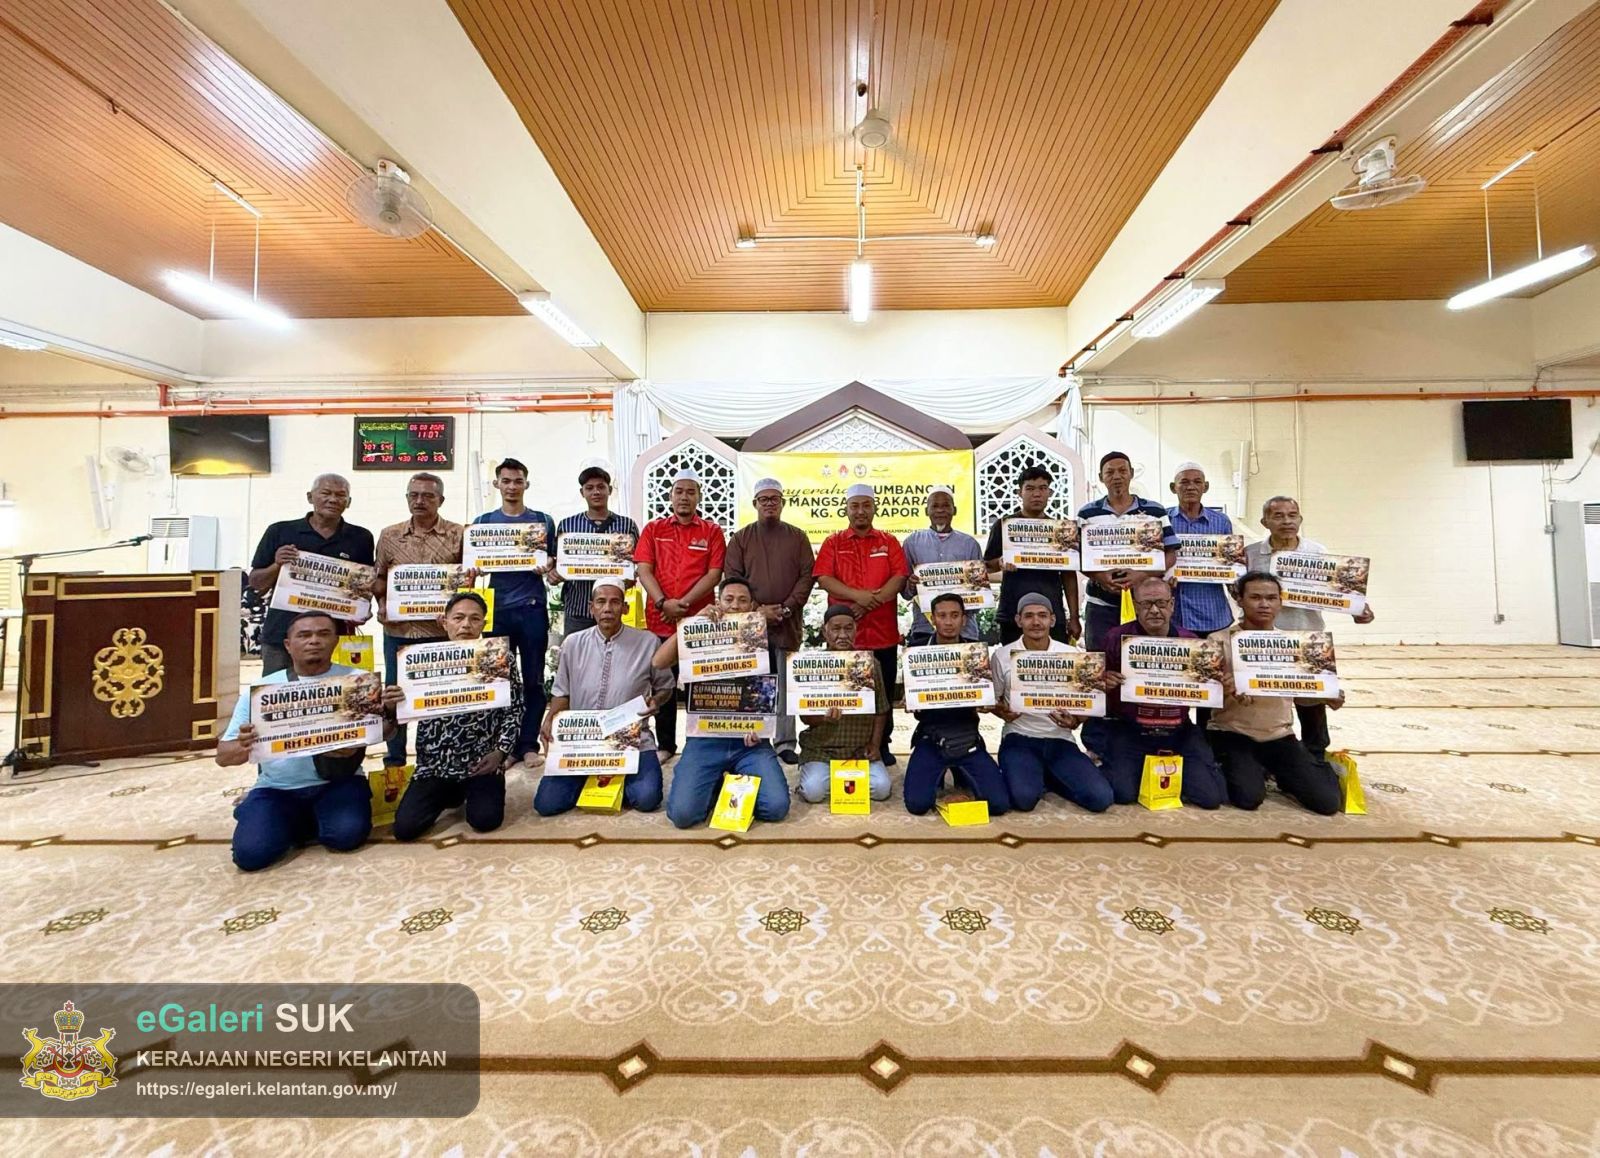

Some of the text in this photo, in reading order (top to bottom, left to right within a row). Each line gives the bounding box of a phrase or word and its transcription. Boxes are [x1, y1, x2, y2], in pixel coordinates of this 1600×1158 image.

[873, 496, 928, 506] BAKARA
[811, 508, 833, 518] KG.
[470, 529, 521, 537] SUMBANGAN
[1008, 524, 1054, 533] SUMBANGAN
[1087, 528, 1136, 536] SUMBANGAN
[563, 538, 610, 546] SUMBANGAN
[291, 558, 350, 577] SUMBANGAN
[1277, 557, 1336, 571] SUMBANGAN
[394, 571, 448, 580] SUMBANGAN
[919, 567, 964, 576] SUMBANGAN
[296, 598, 310, 607] RM
[683, 621, 739, 635] SUMBANGAN
[1238, 639, 1300, 649] SUMBANGAN
[1129, 645, 1190, 657] SUMBANGAN
[406, 649, 474, 665] SUMBANGAN
[908, 651, 961, 664] SUMBANGAN
[792, 659, 845, 669] SUMBANGAN
[1017, 659, 1074, 669] SUMBANGAN
[415, 667, 467, 679] KG GOK KAPOR
[701, 665, 713, 674] RM
[693, 685, 742, 694] SUMBANGAN
[1257, 680, 1271, 689] RM
[261, 686, 342, 706] SUMBANGAN
[926, 694, 938, 702] RM
[1144, 688, 1203, 699] RM 9,000.65
[424, 692, 489, 708] RM 9,000.65
[807, 700, 819, 708] RM
[1032, 699, 1044, 707] RM
[272, 705, 333, 720] KG GOK KAPOR
[558, 718, 600, 728] SUMBAN
[708, 722, 755, 730] RM4,144.44
[284, 730, 359, 750] RM 9,000.65
